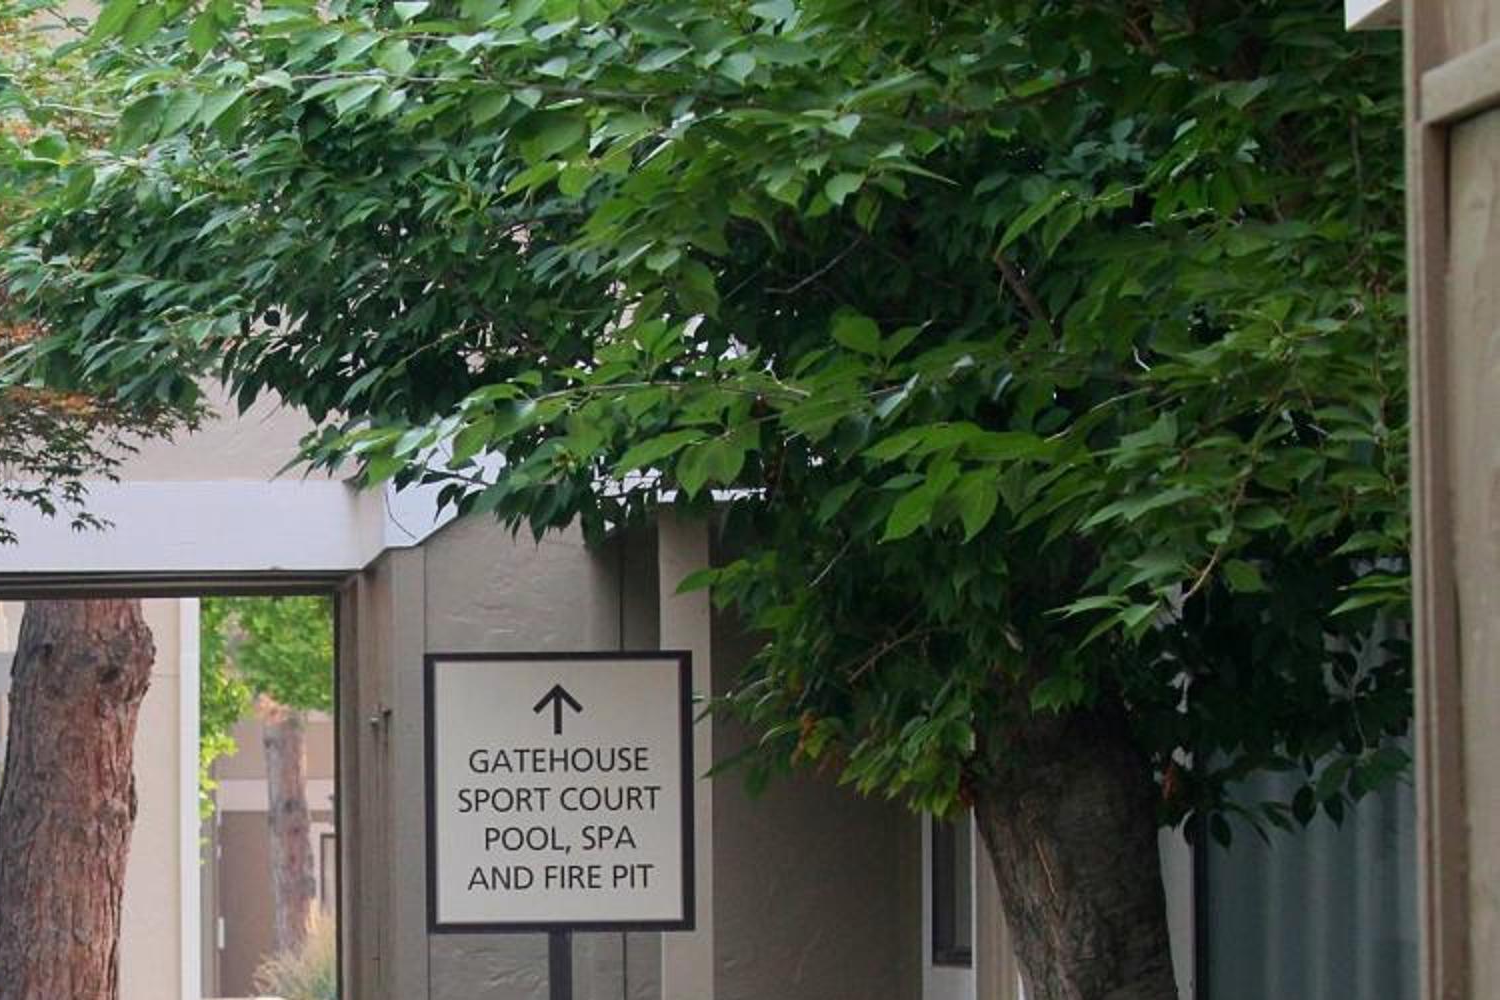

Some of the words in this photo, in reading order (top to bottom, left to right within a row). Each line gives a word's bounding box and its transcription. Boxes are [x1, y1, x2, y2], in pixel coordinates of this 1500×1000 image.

[469, 747, 649, 773] GATEHOUSE
[458, 787, 550, 813] SPORT
[560, 786, 661, 811] COURT
[485, 827, 571, 855] POOL,
[582, 825, 636, 850] SPA
[468, 866, 533, 890] AND
[545, 865, 602, 889] FIRE
[613, 864, 654, 888] PIT
